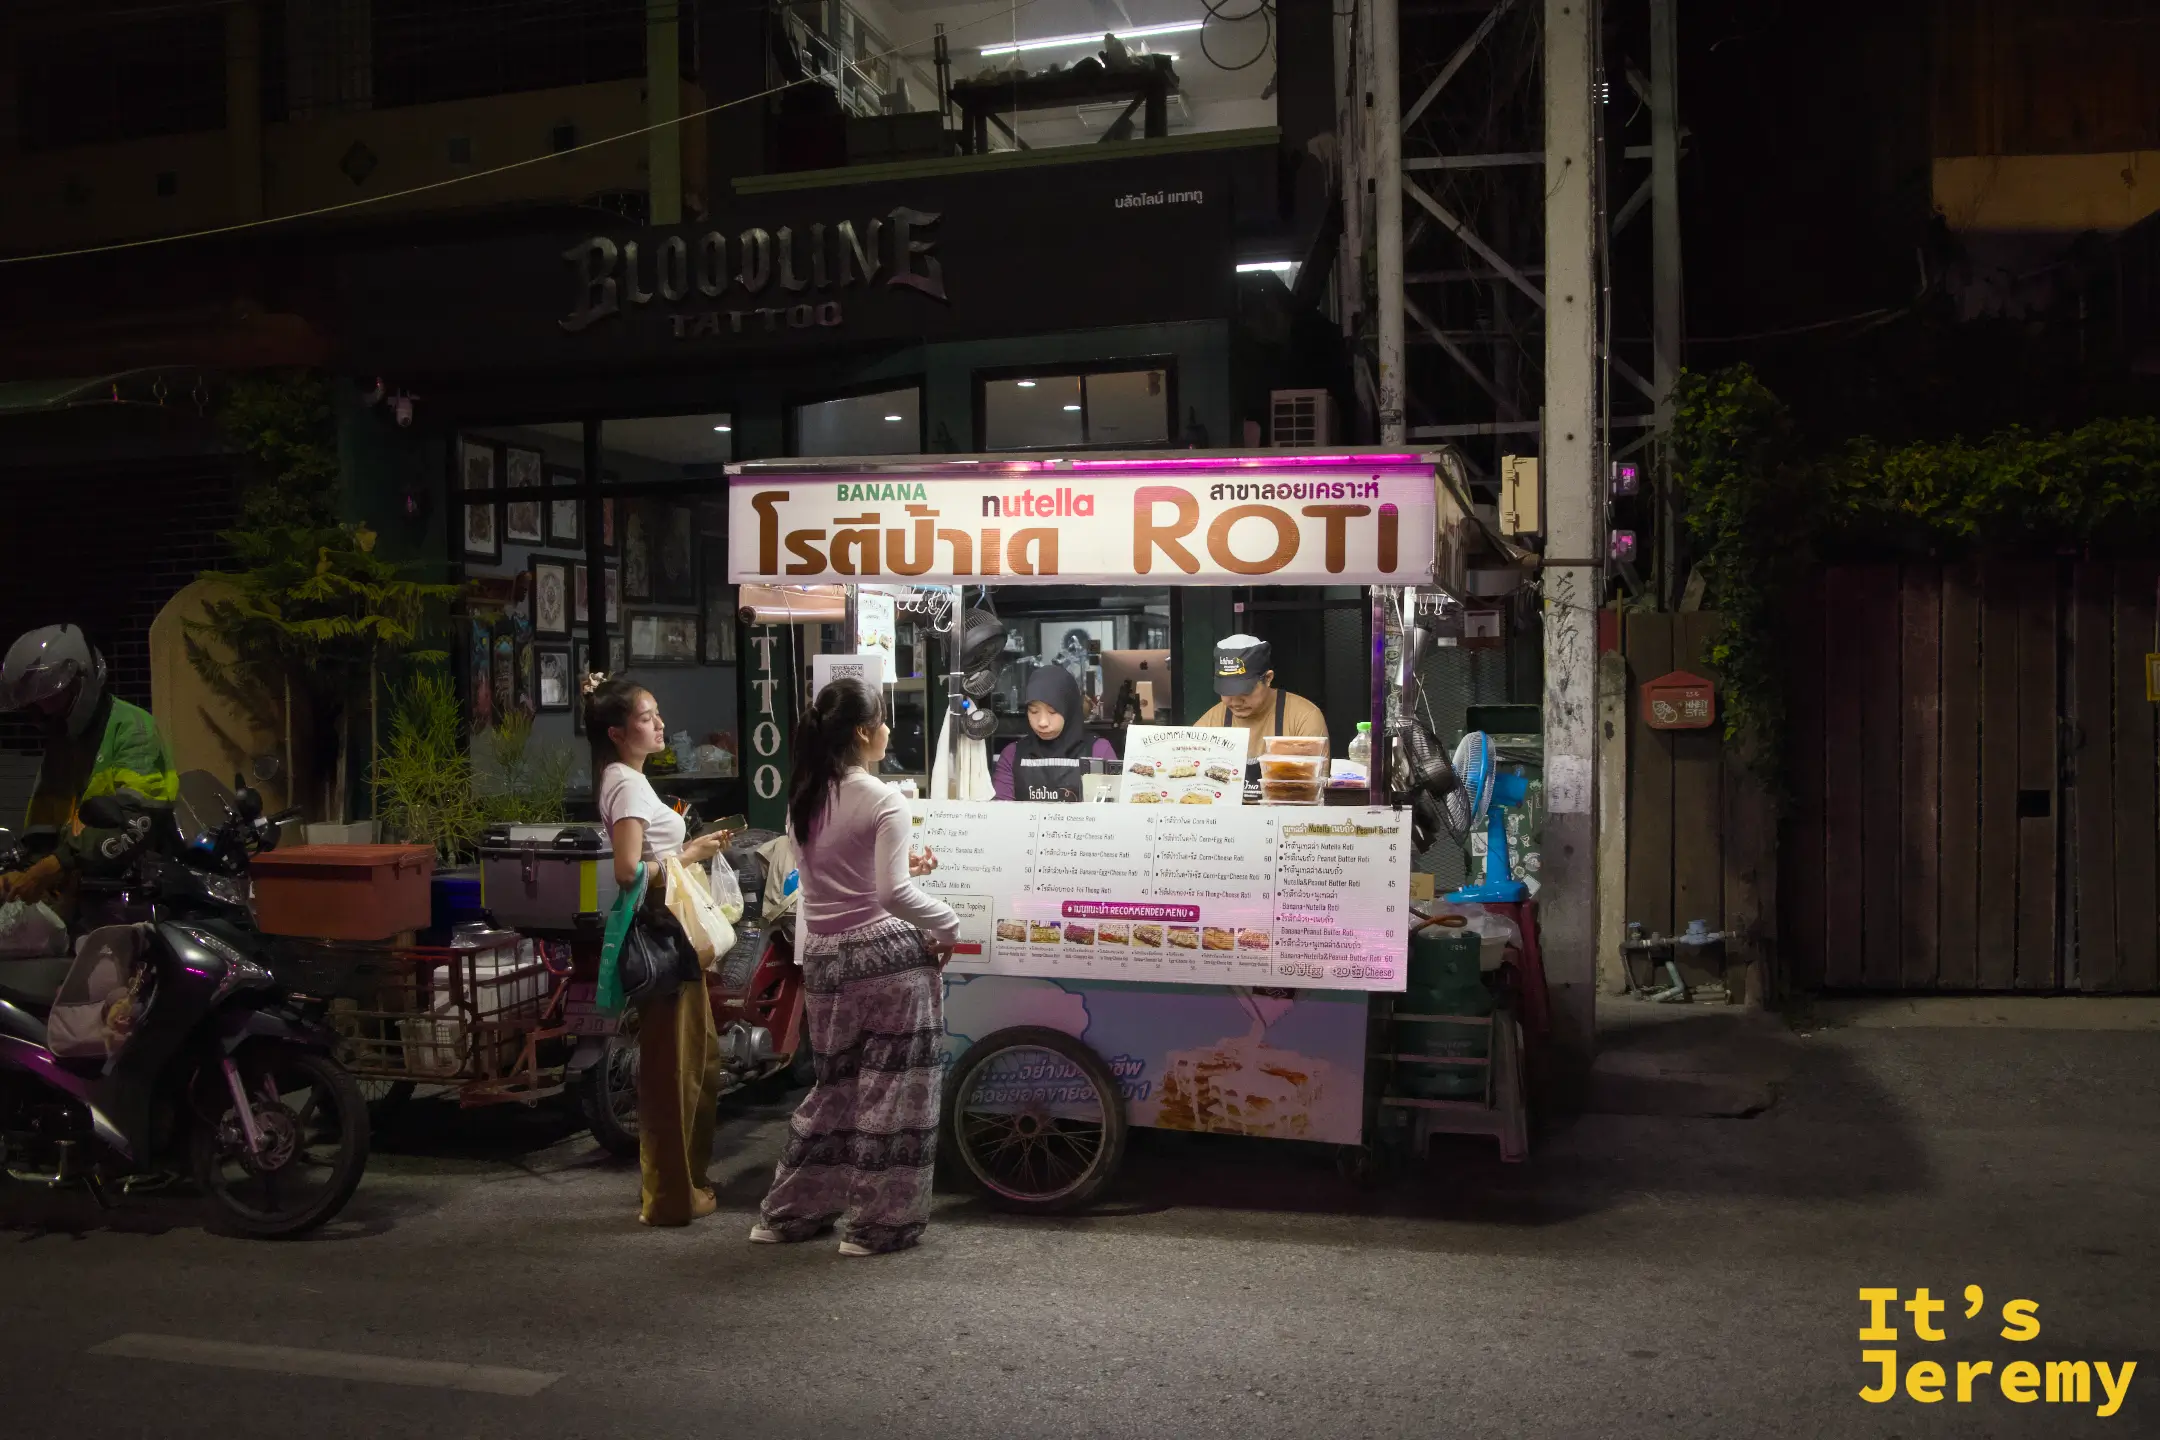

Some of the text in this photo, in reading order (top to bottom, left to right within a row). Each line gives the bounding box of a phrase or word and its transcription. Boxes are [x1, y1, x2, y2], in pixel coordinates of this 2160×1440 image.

[557, 205, 951, 332] BLOODLINE
[671, 301, 844, 338] TATTOO
[837, 483, 927, 501] BANANA
[1210, 474, 1381, 501] สาขาลอยเคราะห์
[982, 487, 1094, 517] nutella
[751, 490, 1059, 576] โรตีป้าเด
[1133, 486, 1399, 575] ROTI
[1142, 731, 1208, 746] RECOMMENDED
[1308, 823, 1331, 834] Nutella
[1331, 818, 1355, 834] เนยถั่ว
[1356, 826, 1377, 835] Peanut
[1378, 826, 1399, 835] Butter
[1320, 843, 1341, 851] Nutella
[1342, 843, 1354, 851] Roti
[1388, 843, 1397, 851] 45
[1316, 854, 1337, 863] Peanut
[1337, 854, 1356, 863] Butter
[1357, 855, 1370, 863] Roti
[1023, 884, 1031, 892] 35
[1283, 878, 1396, 888] Nutella&Peanut Butter Roti 45
[1141, 888, 1149, 896] 40
[1262, 892, 1270, 900] 60
[967, 902, 986, 911] Topping
[1110, 906, 1164, 916] RECOMMENDED
[1165, 908, 1188, 918] MENU
[1327, 903, 1340, 911] Roti
[1386, 905, 1395, 913] 60
[1281, 927, 1394, 938] Banana+Peanut Butter Roti 60
[1349, 953, 1368, 962] Butter
[1384, 955, 1393, 963] 60
[1280, 965, 1293, 974] +10
[1307, 965, 1323, 976] Egg
[1332, 966, 1349, 976] +20
[1365, 967, 1392, 977] Cheese
